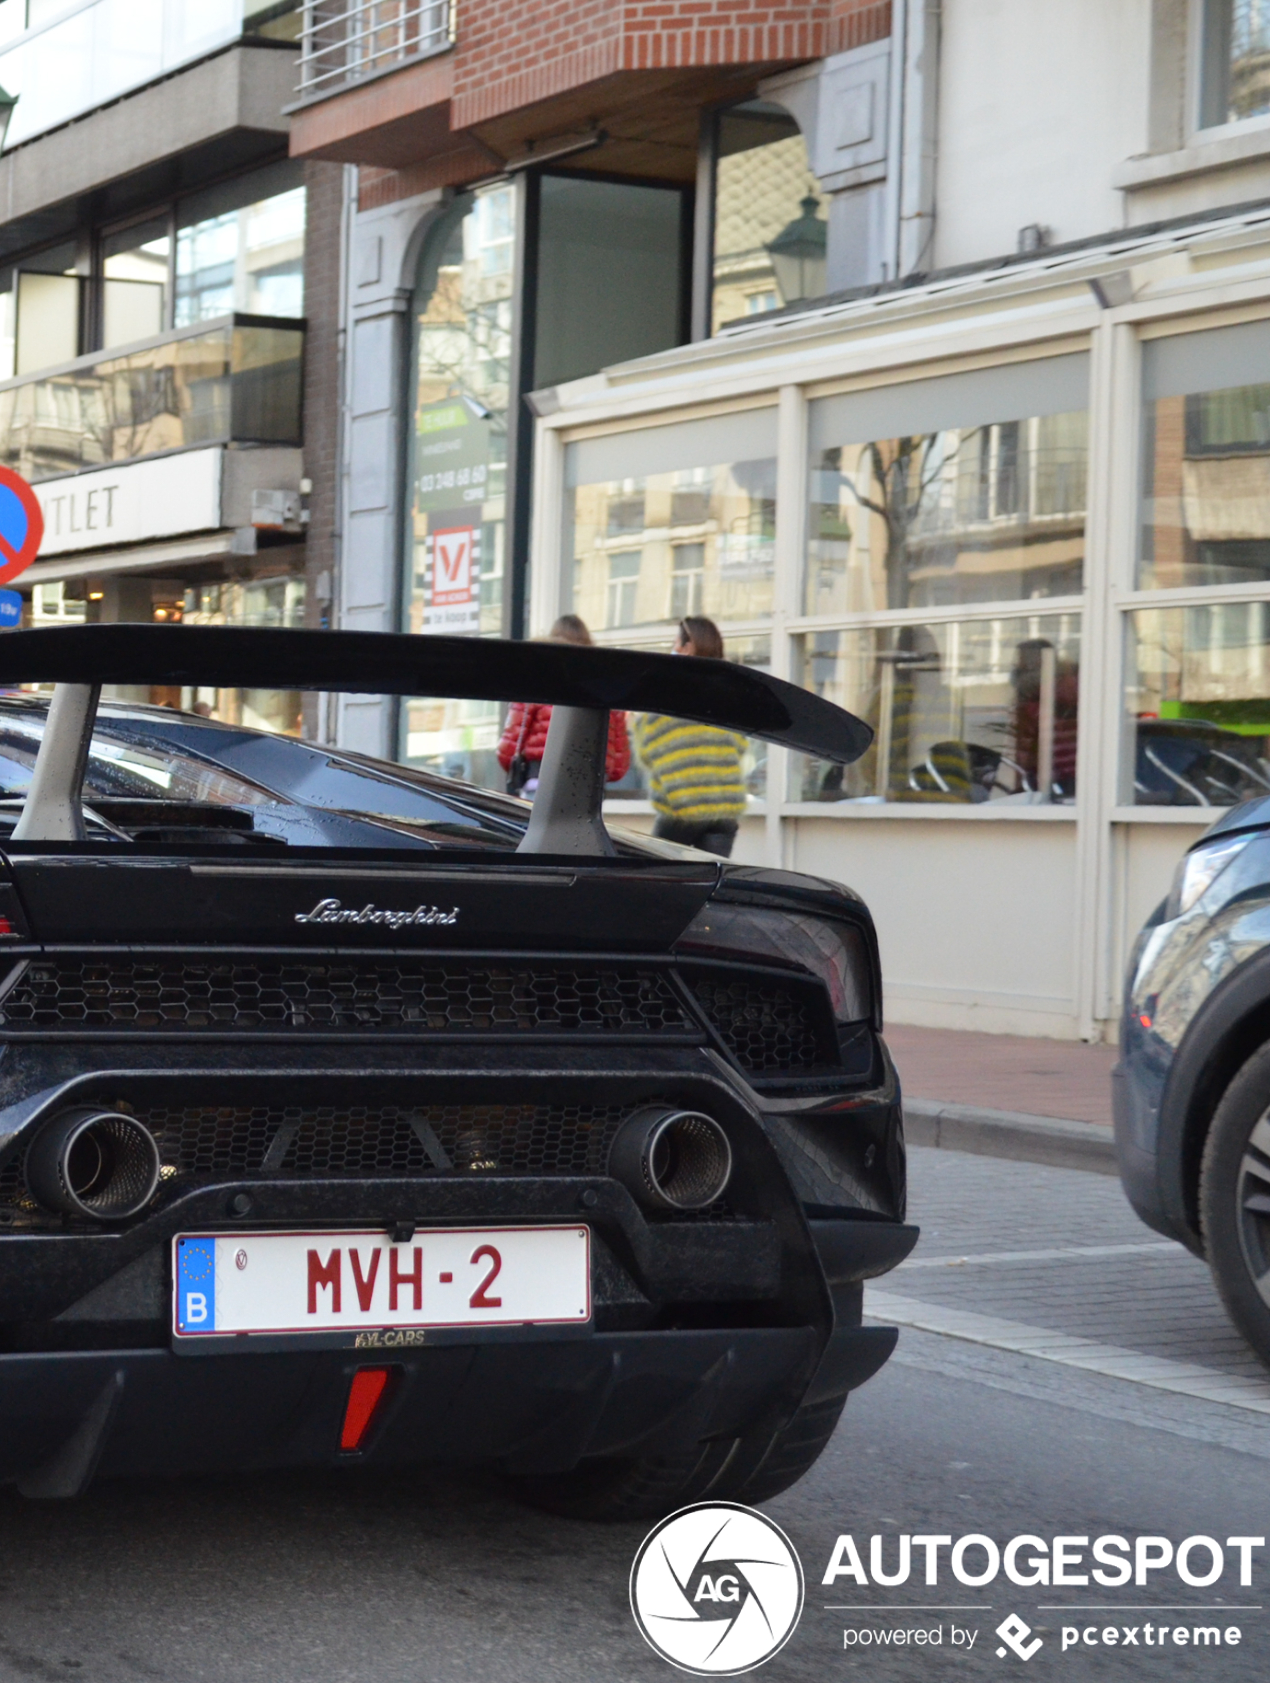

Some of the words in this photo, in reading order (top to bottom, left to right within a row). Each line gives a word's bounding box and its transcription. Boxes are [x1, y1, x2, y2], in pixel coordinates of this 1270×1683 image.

[0, 603, 18, 616] 19u
[294, 898, 461, 930] Lamborghini
[307, 1244, 502, 1314] MVH-2
[186, 1292, 208, 1323] B
